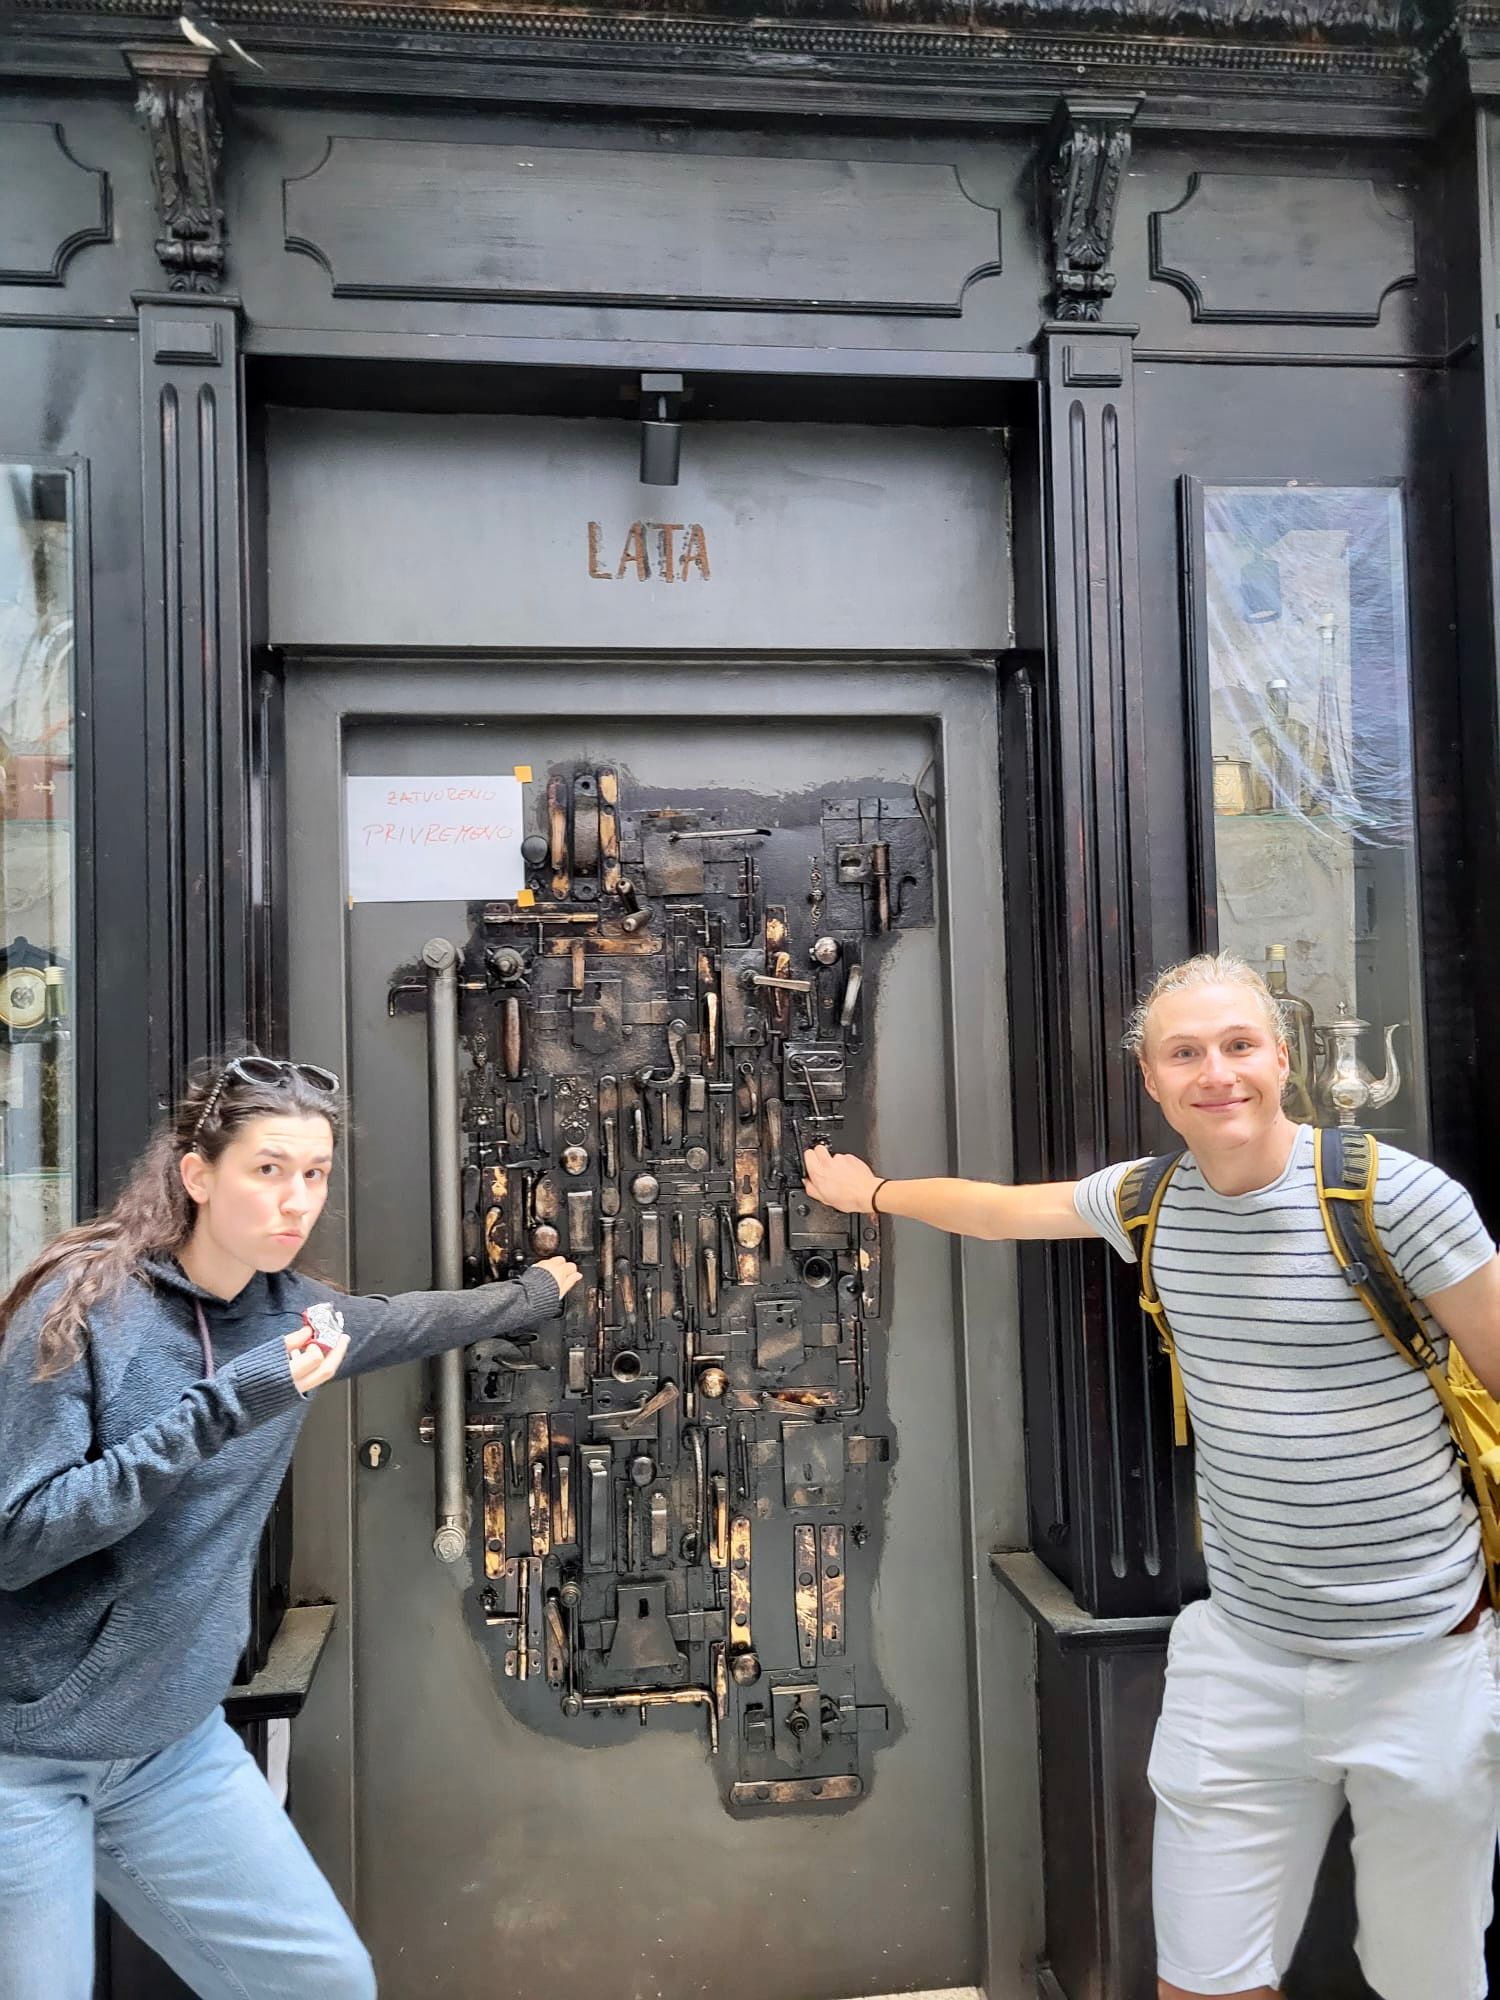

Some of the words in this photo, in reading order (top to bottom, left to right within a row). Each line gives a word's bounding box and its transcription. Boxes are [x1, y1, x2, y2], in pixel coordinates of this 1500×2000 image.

[588, 521, 711, 583] LATA
[387, 787, 496, 806] ZATVORENO
[363, 823, 513, 846] PRIVREMENO
